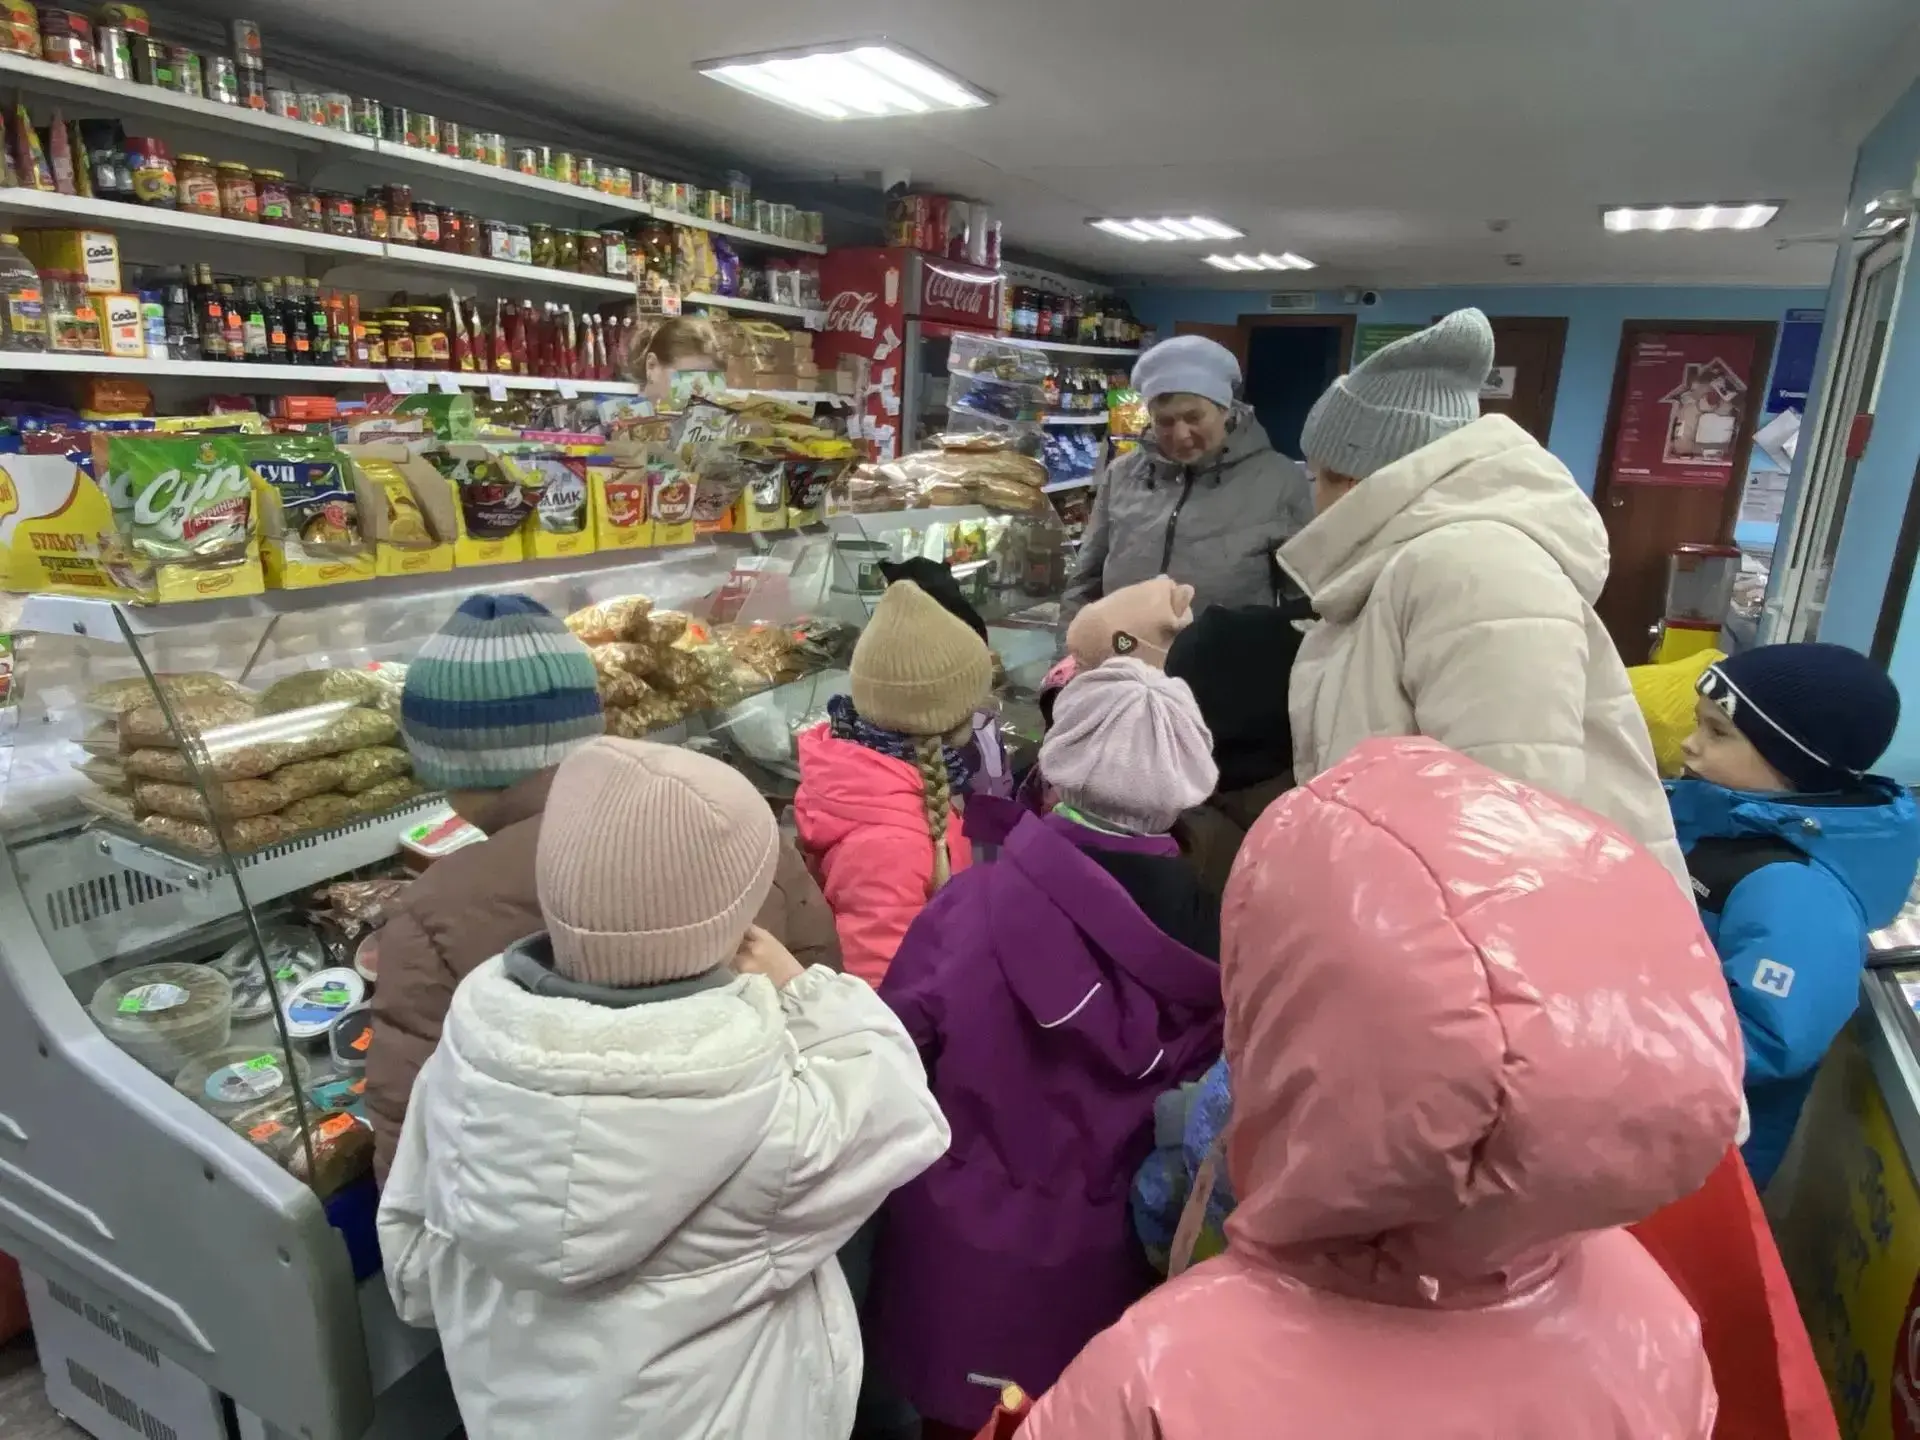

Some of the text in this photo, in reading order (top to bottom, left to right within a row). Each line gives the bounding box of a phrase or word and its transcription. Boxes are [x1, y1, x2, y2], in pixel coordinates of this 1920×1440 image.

[87, 246, 113, 257] Сода
[111, 310, 137, 321] Сода
[134, 465, 249, 540] Суп
